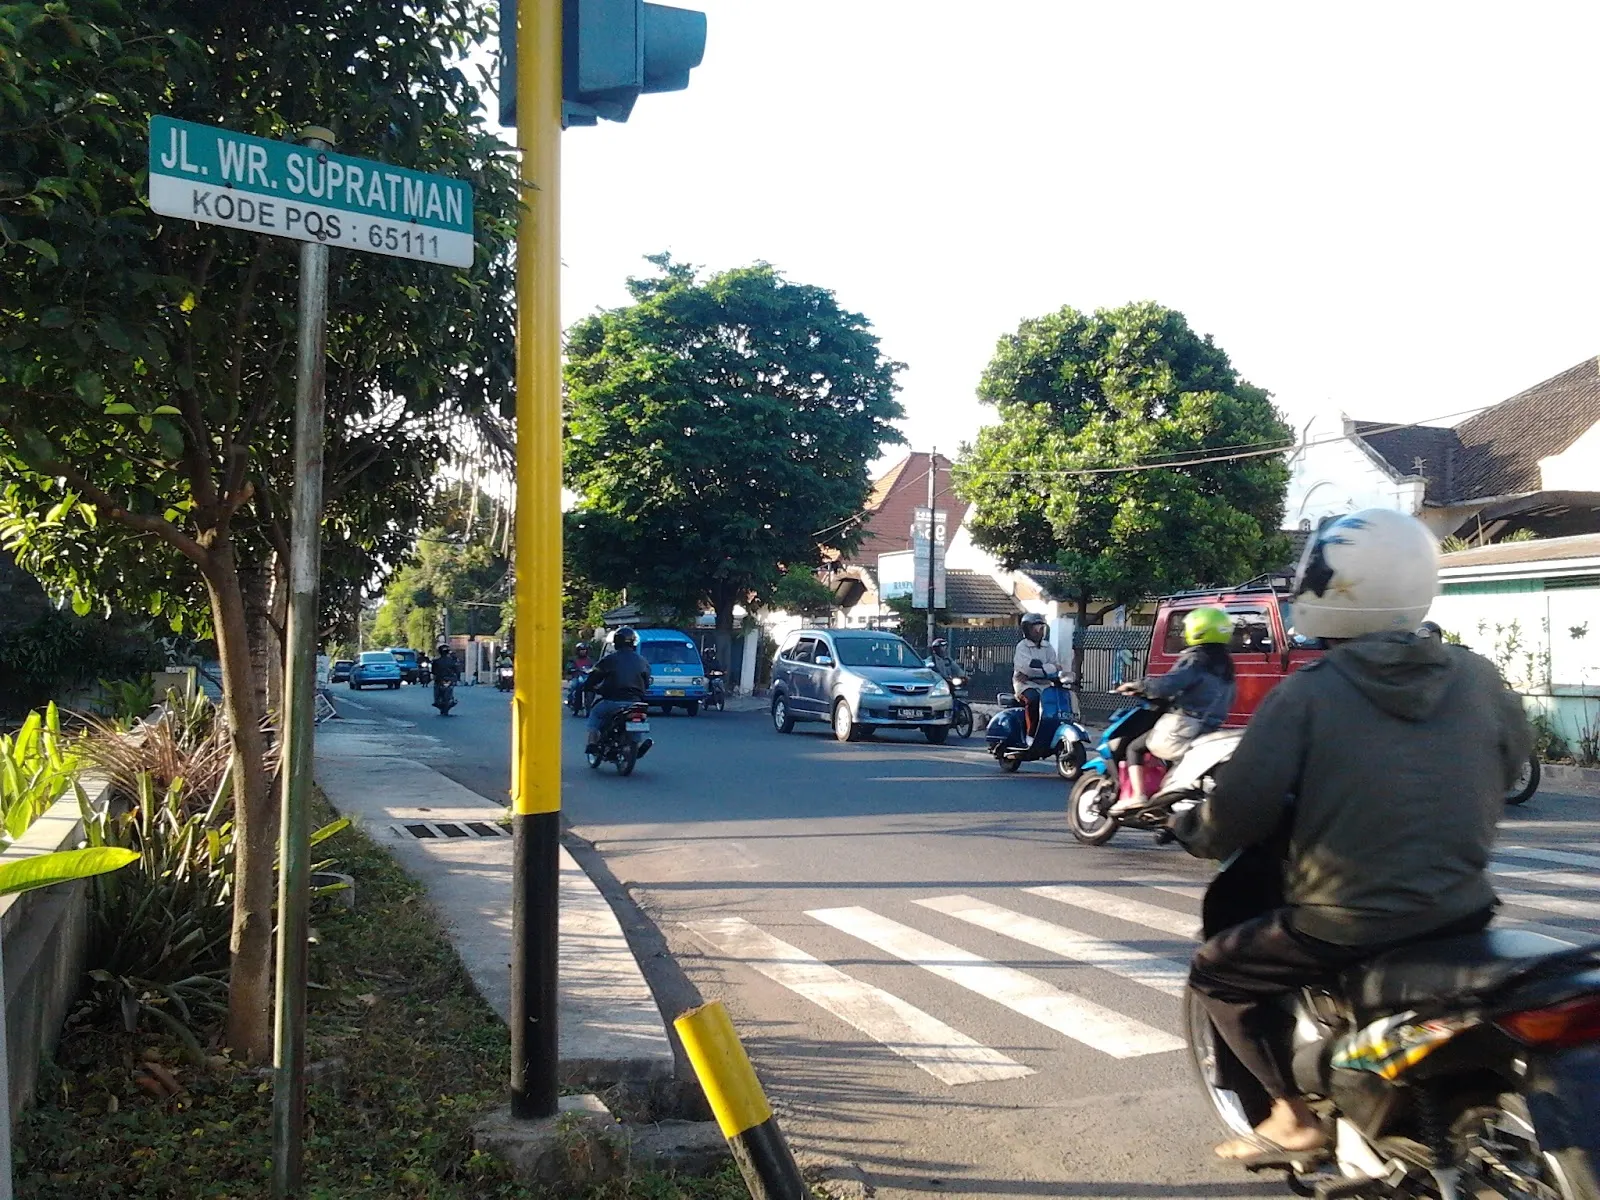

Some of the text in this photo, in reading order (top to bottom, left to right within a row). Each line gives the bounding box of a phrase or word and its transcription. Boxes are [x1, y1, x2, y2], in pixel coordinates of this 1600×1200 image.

[161, 127, 463, 225] JL. WR. SUPRATMAN
[193, 189, 276, 228] KODE
[286, 207, 341, 240] POS
[368, 224, 438, 258] 65111
